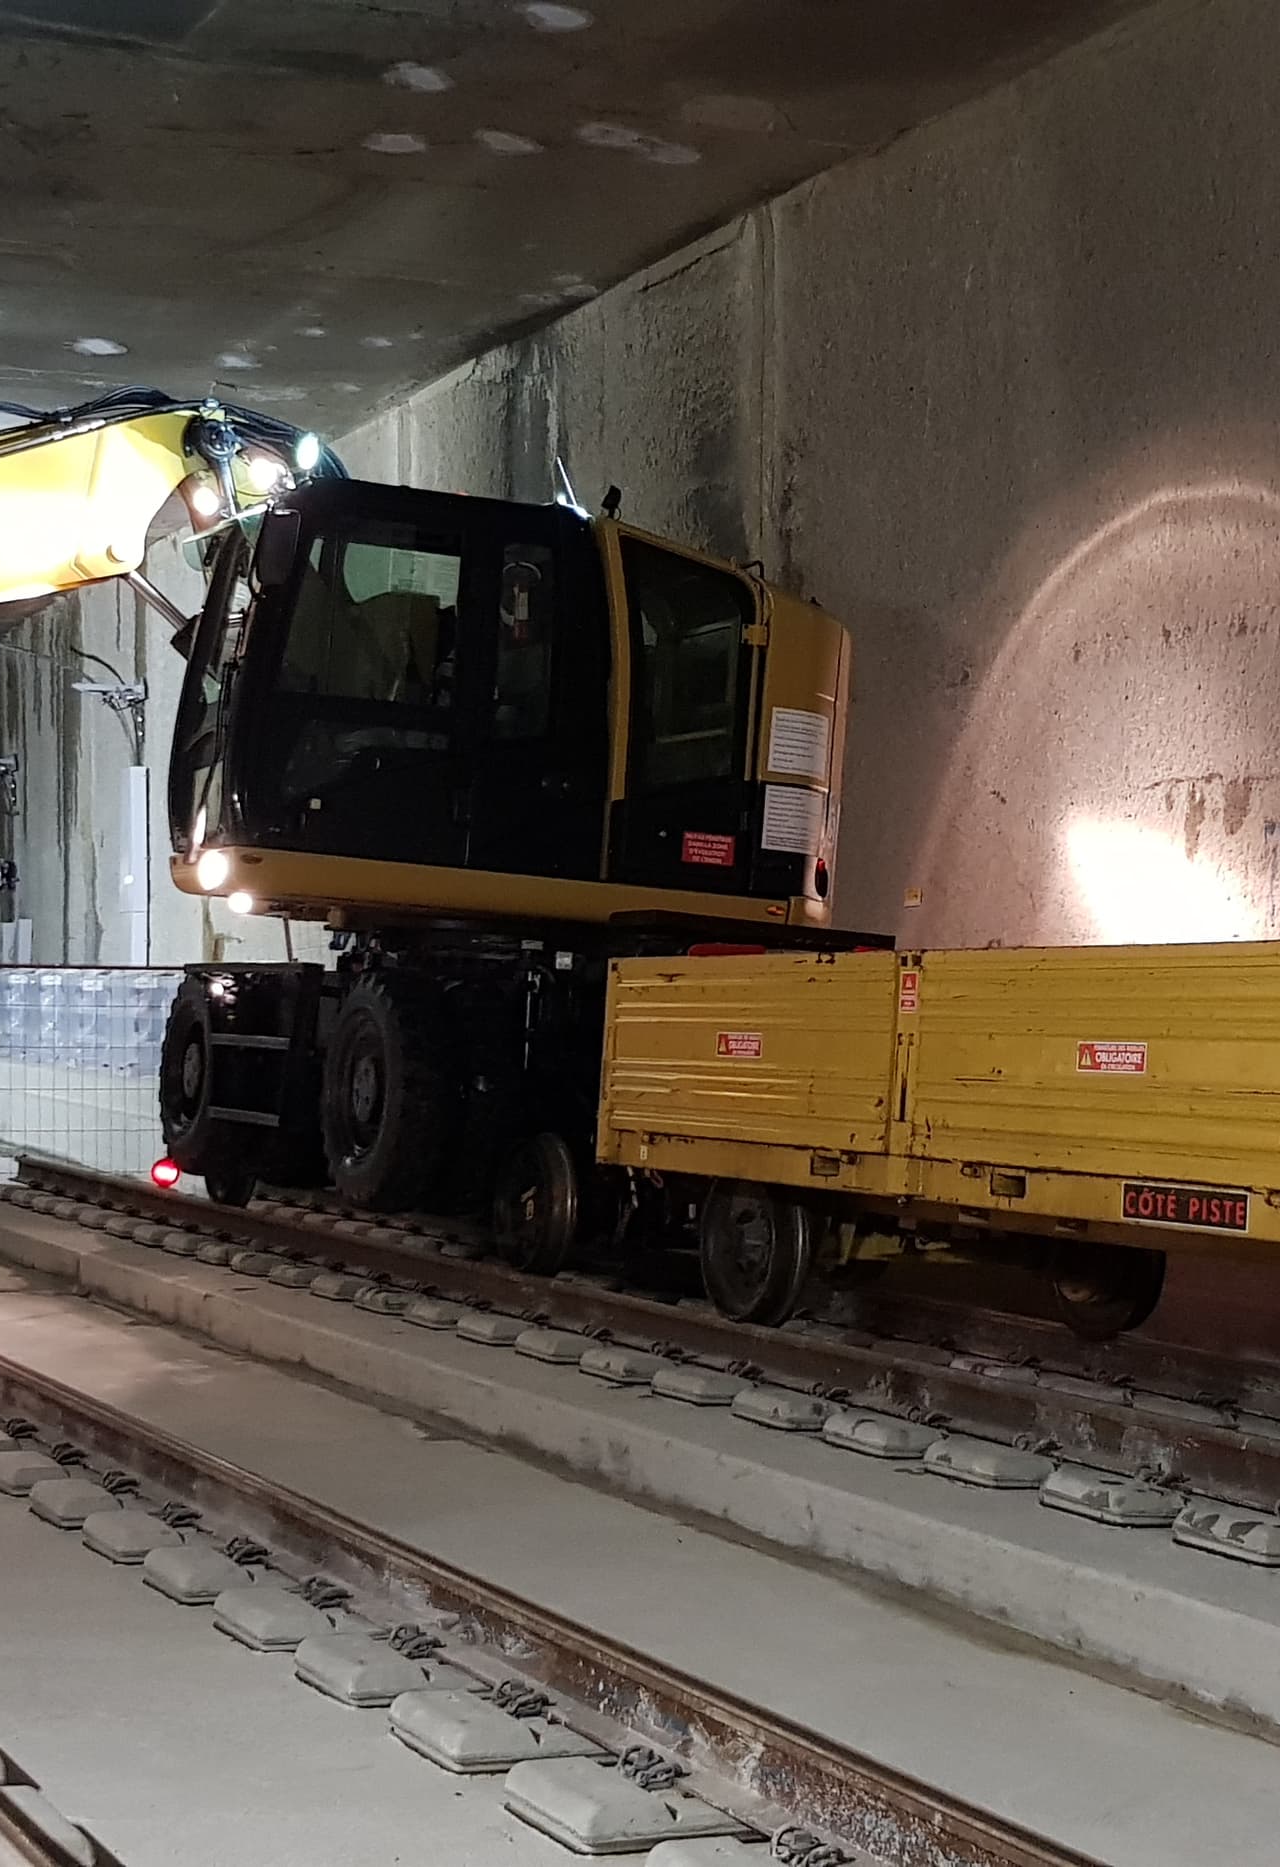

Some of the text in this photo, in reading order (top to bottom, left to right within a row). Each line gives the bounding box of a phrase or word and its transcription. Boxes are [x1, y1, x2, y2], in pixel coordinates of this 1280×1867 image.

[1095, 1051, 1143, 1064] OBLIGATOIRE
[1125, 1188, 1246, 1226] CÔTÉ PISTE
